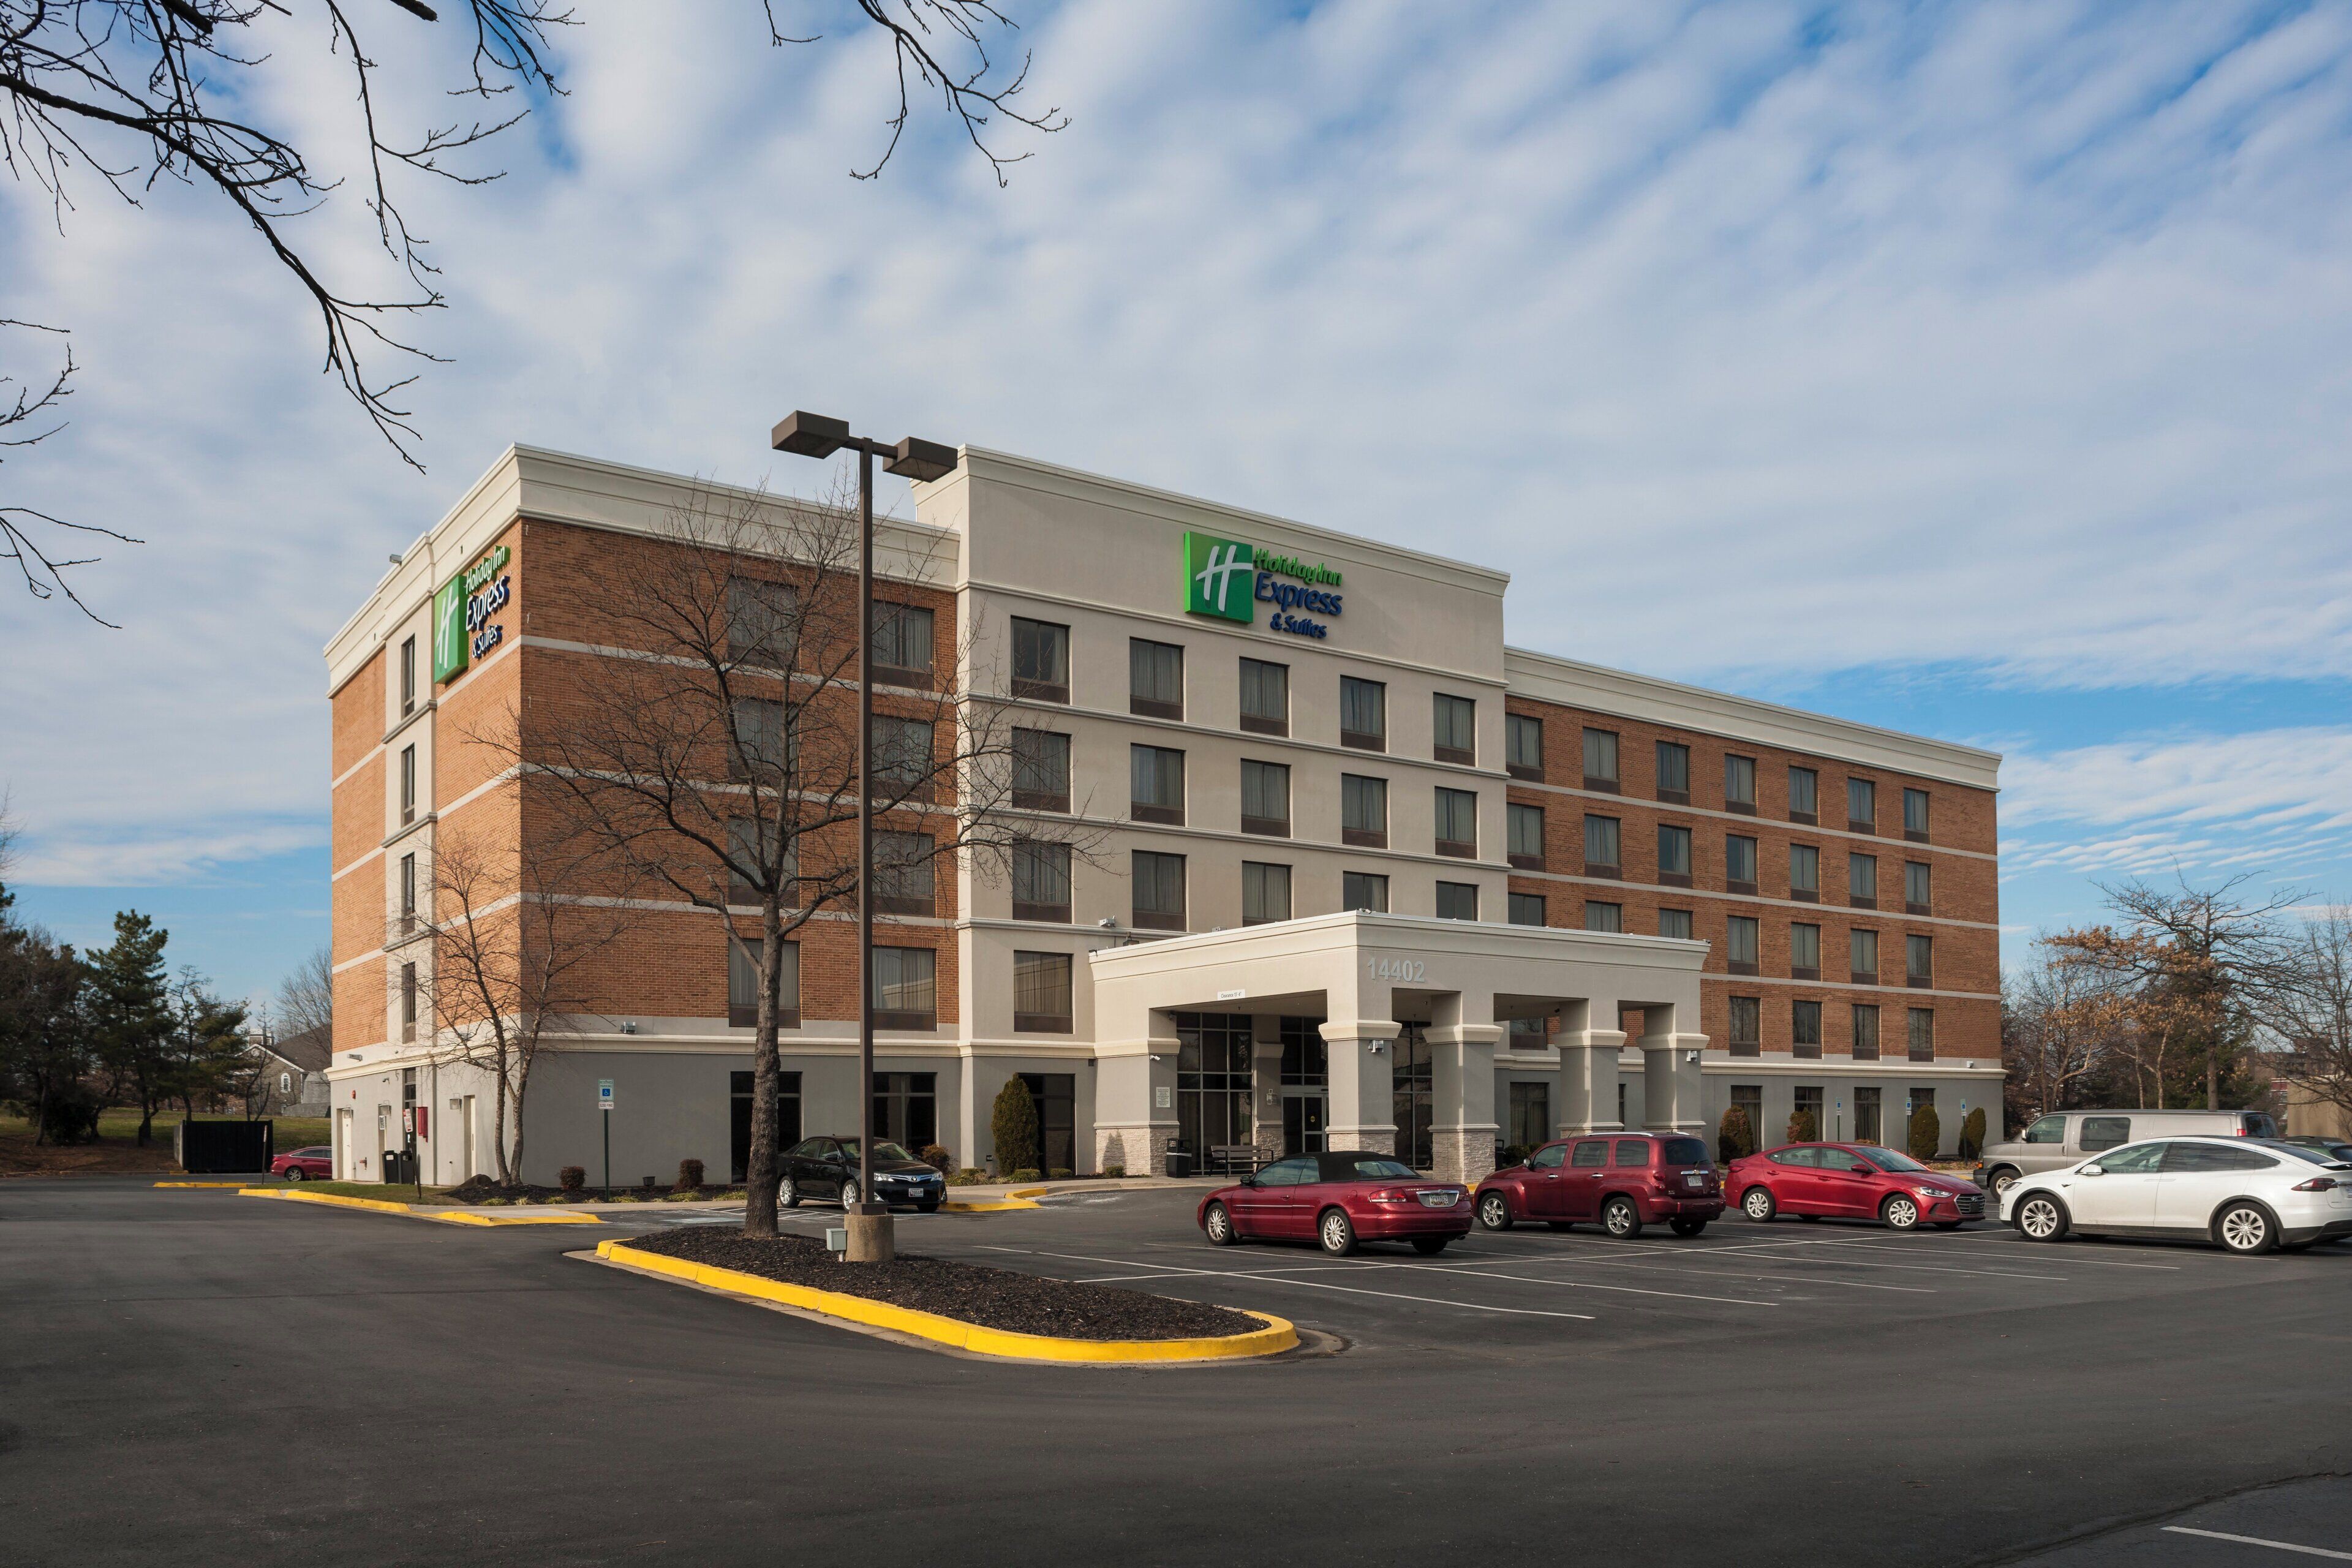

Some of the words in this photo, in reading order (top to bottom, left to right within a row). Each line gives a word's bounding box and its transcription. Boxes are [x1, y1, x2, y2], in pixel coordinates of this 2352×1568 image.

[466, 559, 494, 594] Holiday
[493, 545, 507, 570] Inn
[1254, 548, 1316, 585] Holiday
[1317, 562, 1343, 586] Inn
[466, 575, 507, 631] Express
[1254, 572, 1343, 616] Express
[477, 624, 499, 654] Suites
[1270, 612, 1283, 631] &
[1283, 614, 1327, 638] Suites
[1368, 957, 1426, 982] 14402
